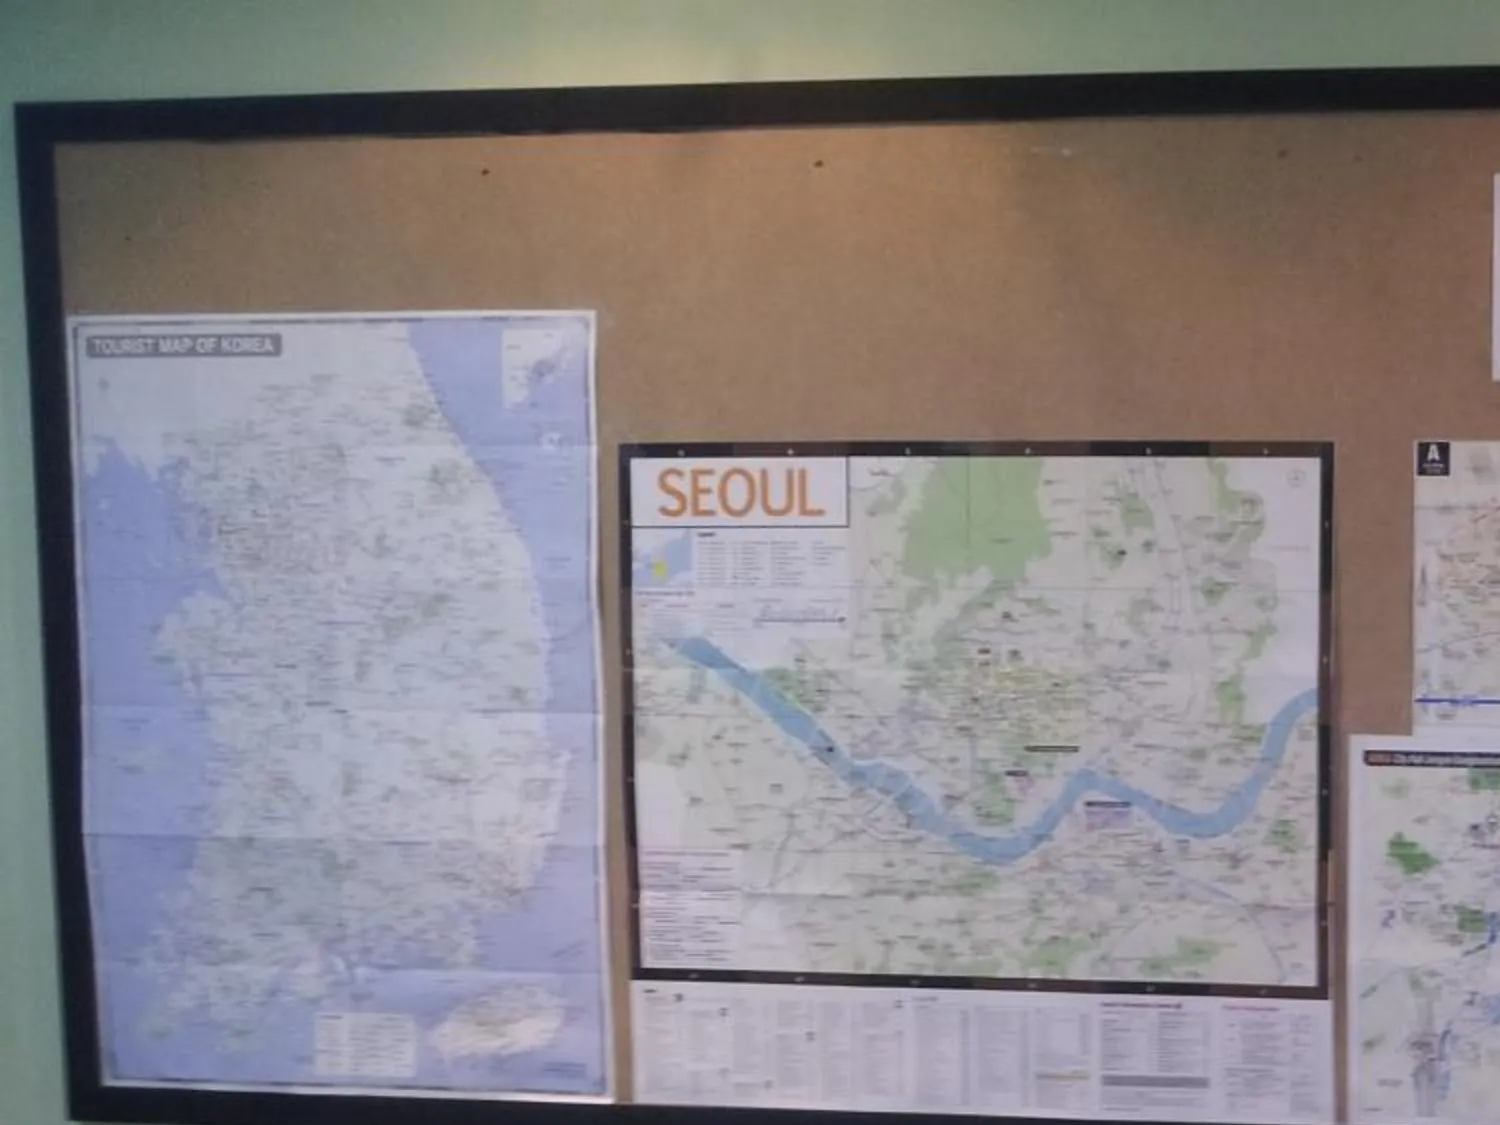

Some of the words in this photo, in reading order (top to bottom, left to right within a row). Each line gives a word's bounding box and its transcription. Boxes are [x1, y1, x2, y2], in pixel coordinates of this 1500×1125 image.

[94, 338, 155, 354] TOURIST
[158, 337, 193, 353] MAP
[194, 337, 218, 353] OF
[220, 336, 274, 353] KOREA
[1426, 444, 1441, 462] A
[657, 467, 827, 518] SEOUL
